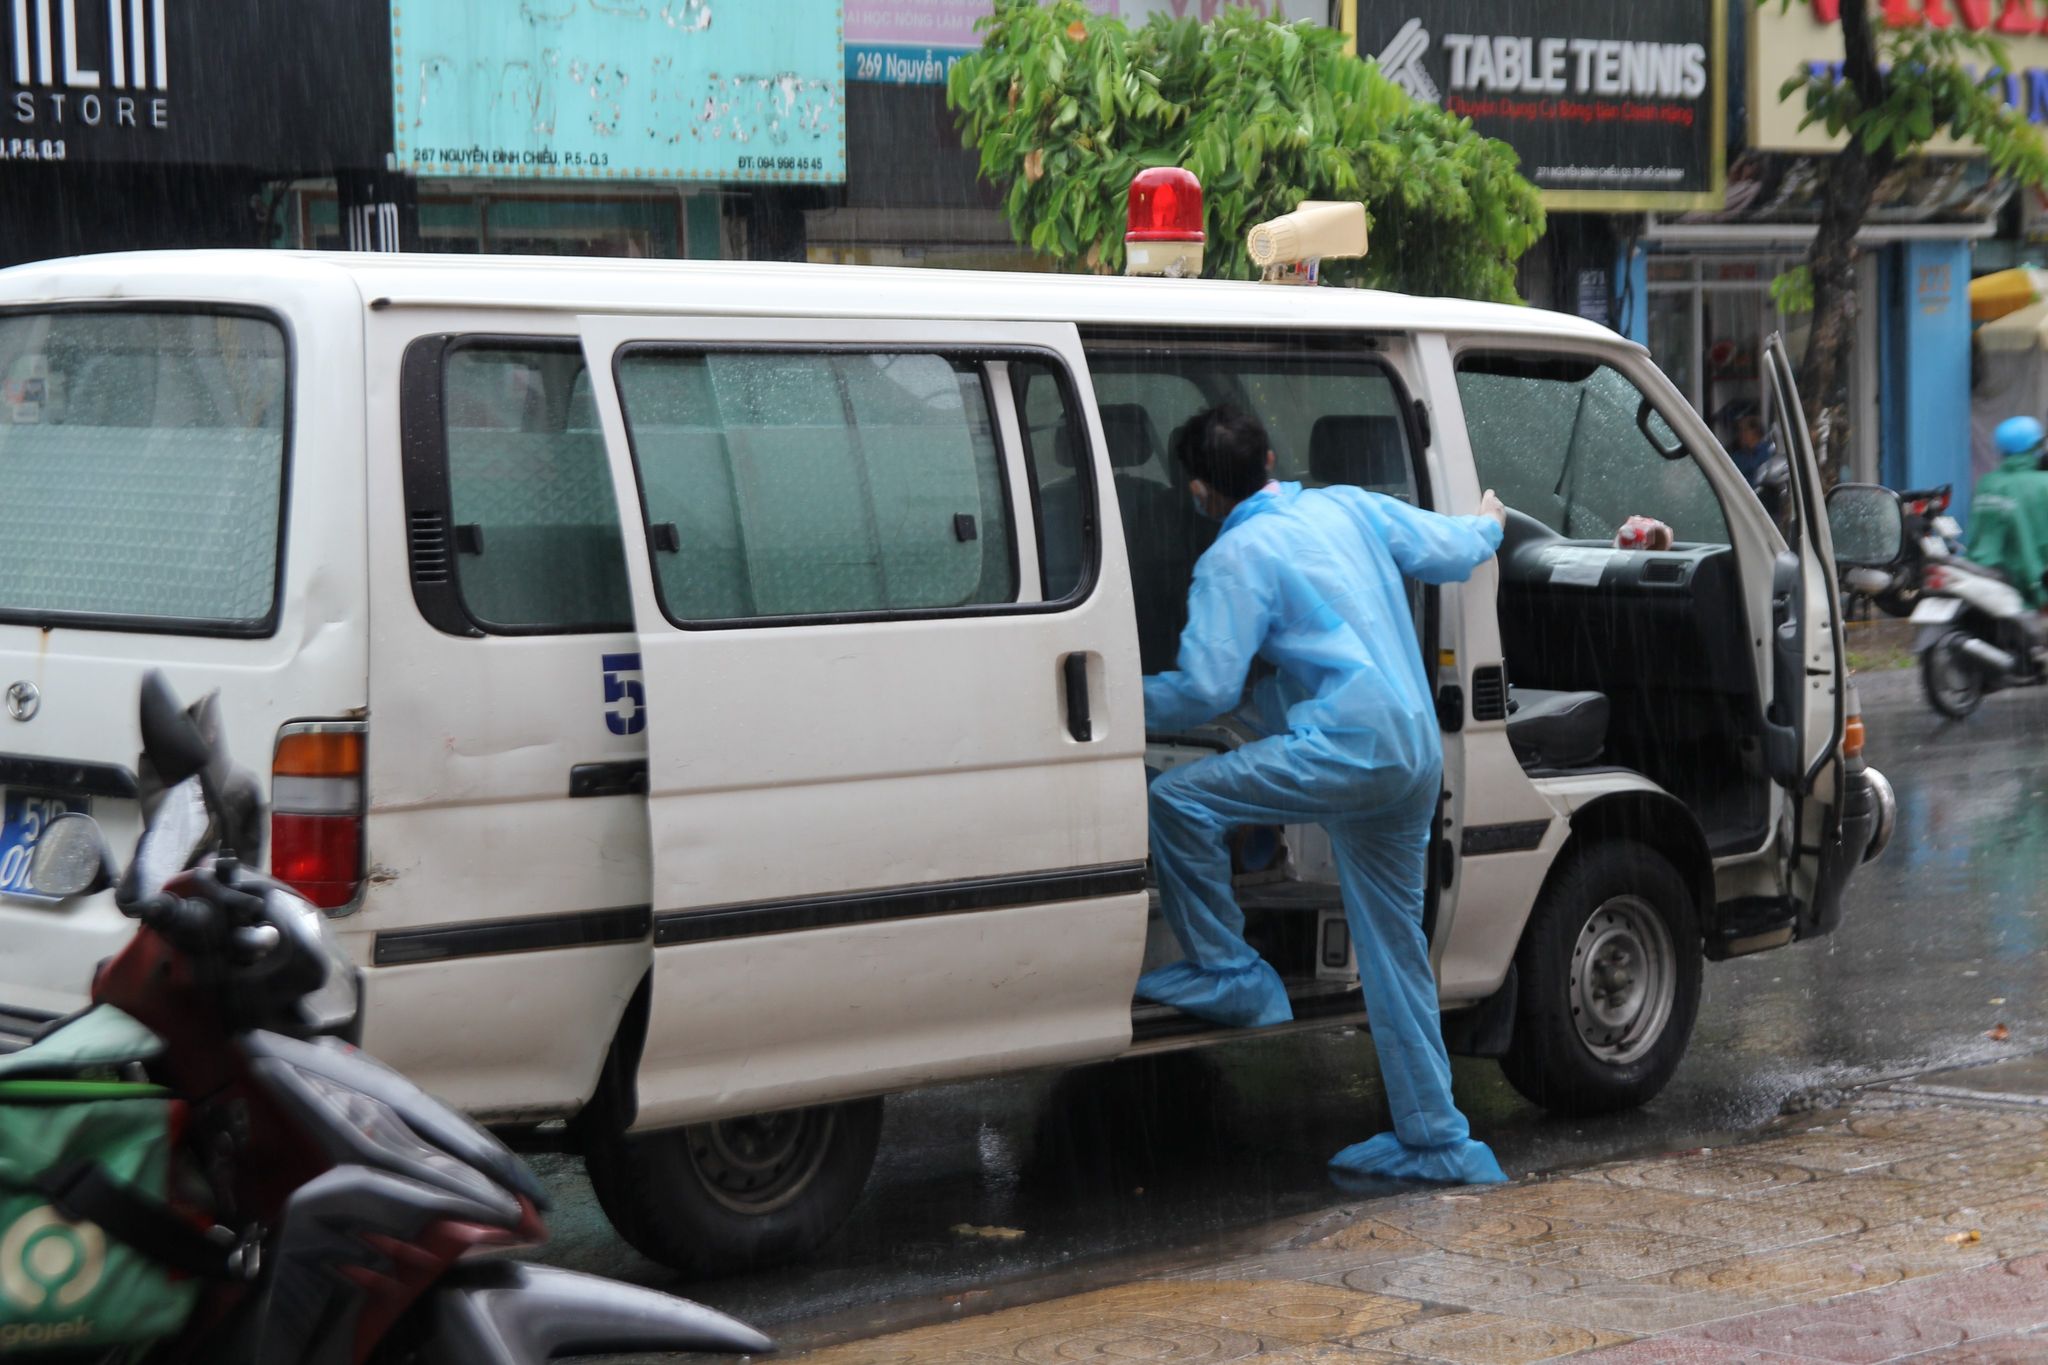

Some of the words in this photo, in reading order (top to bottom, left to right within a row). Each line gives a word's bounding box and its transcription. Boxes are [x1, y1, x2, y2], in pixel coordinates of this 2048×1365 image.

[857, 52, 882, 79] 269
[886, 49, 943, 85] Nguyễn
[1443, 33, 1568, 95] TABLE
[1570, 37, 1707, 100] TENNIS
[15, 91, 168, 128] STORE
[414, 149, 435, 162] 267
[439, 144, 489, 163] NGUYỄN
[492, 147, 519, 164] ĐÌNH
